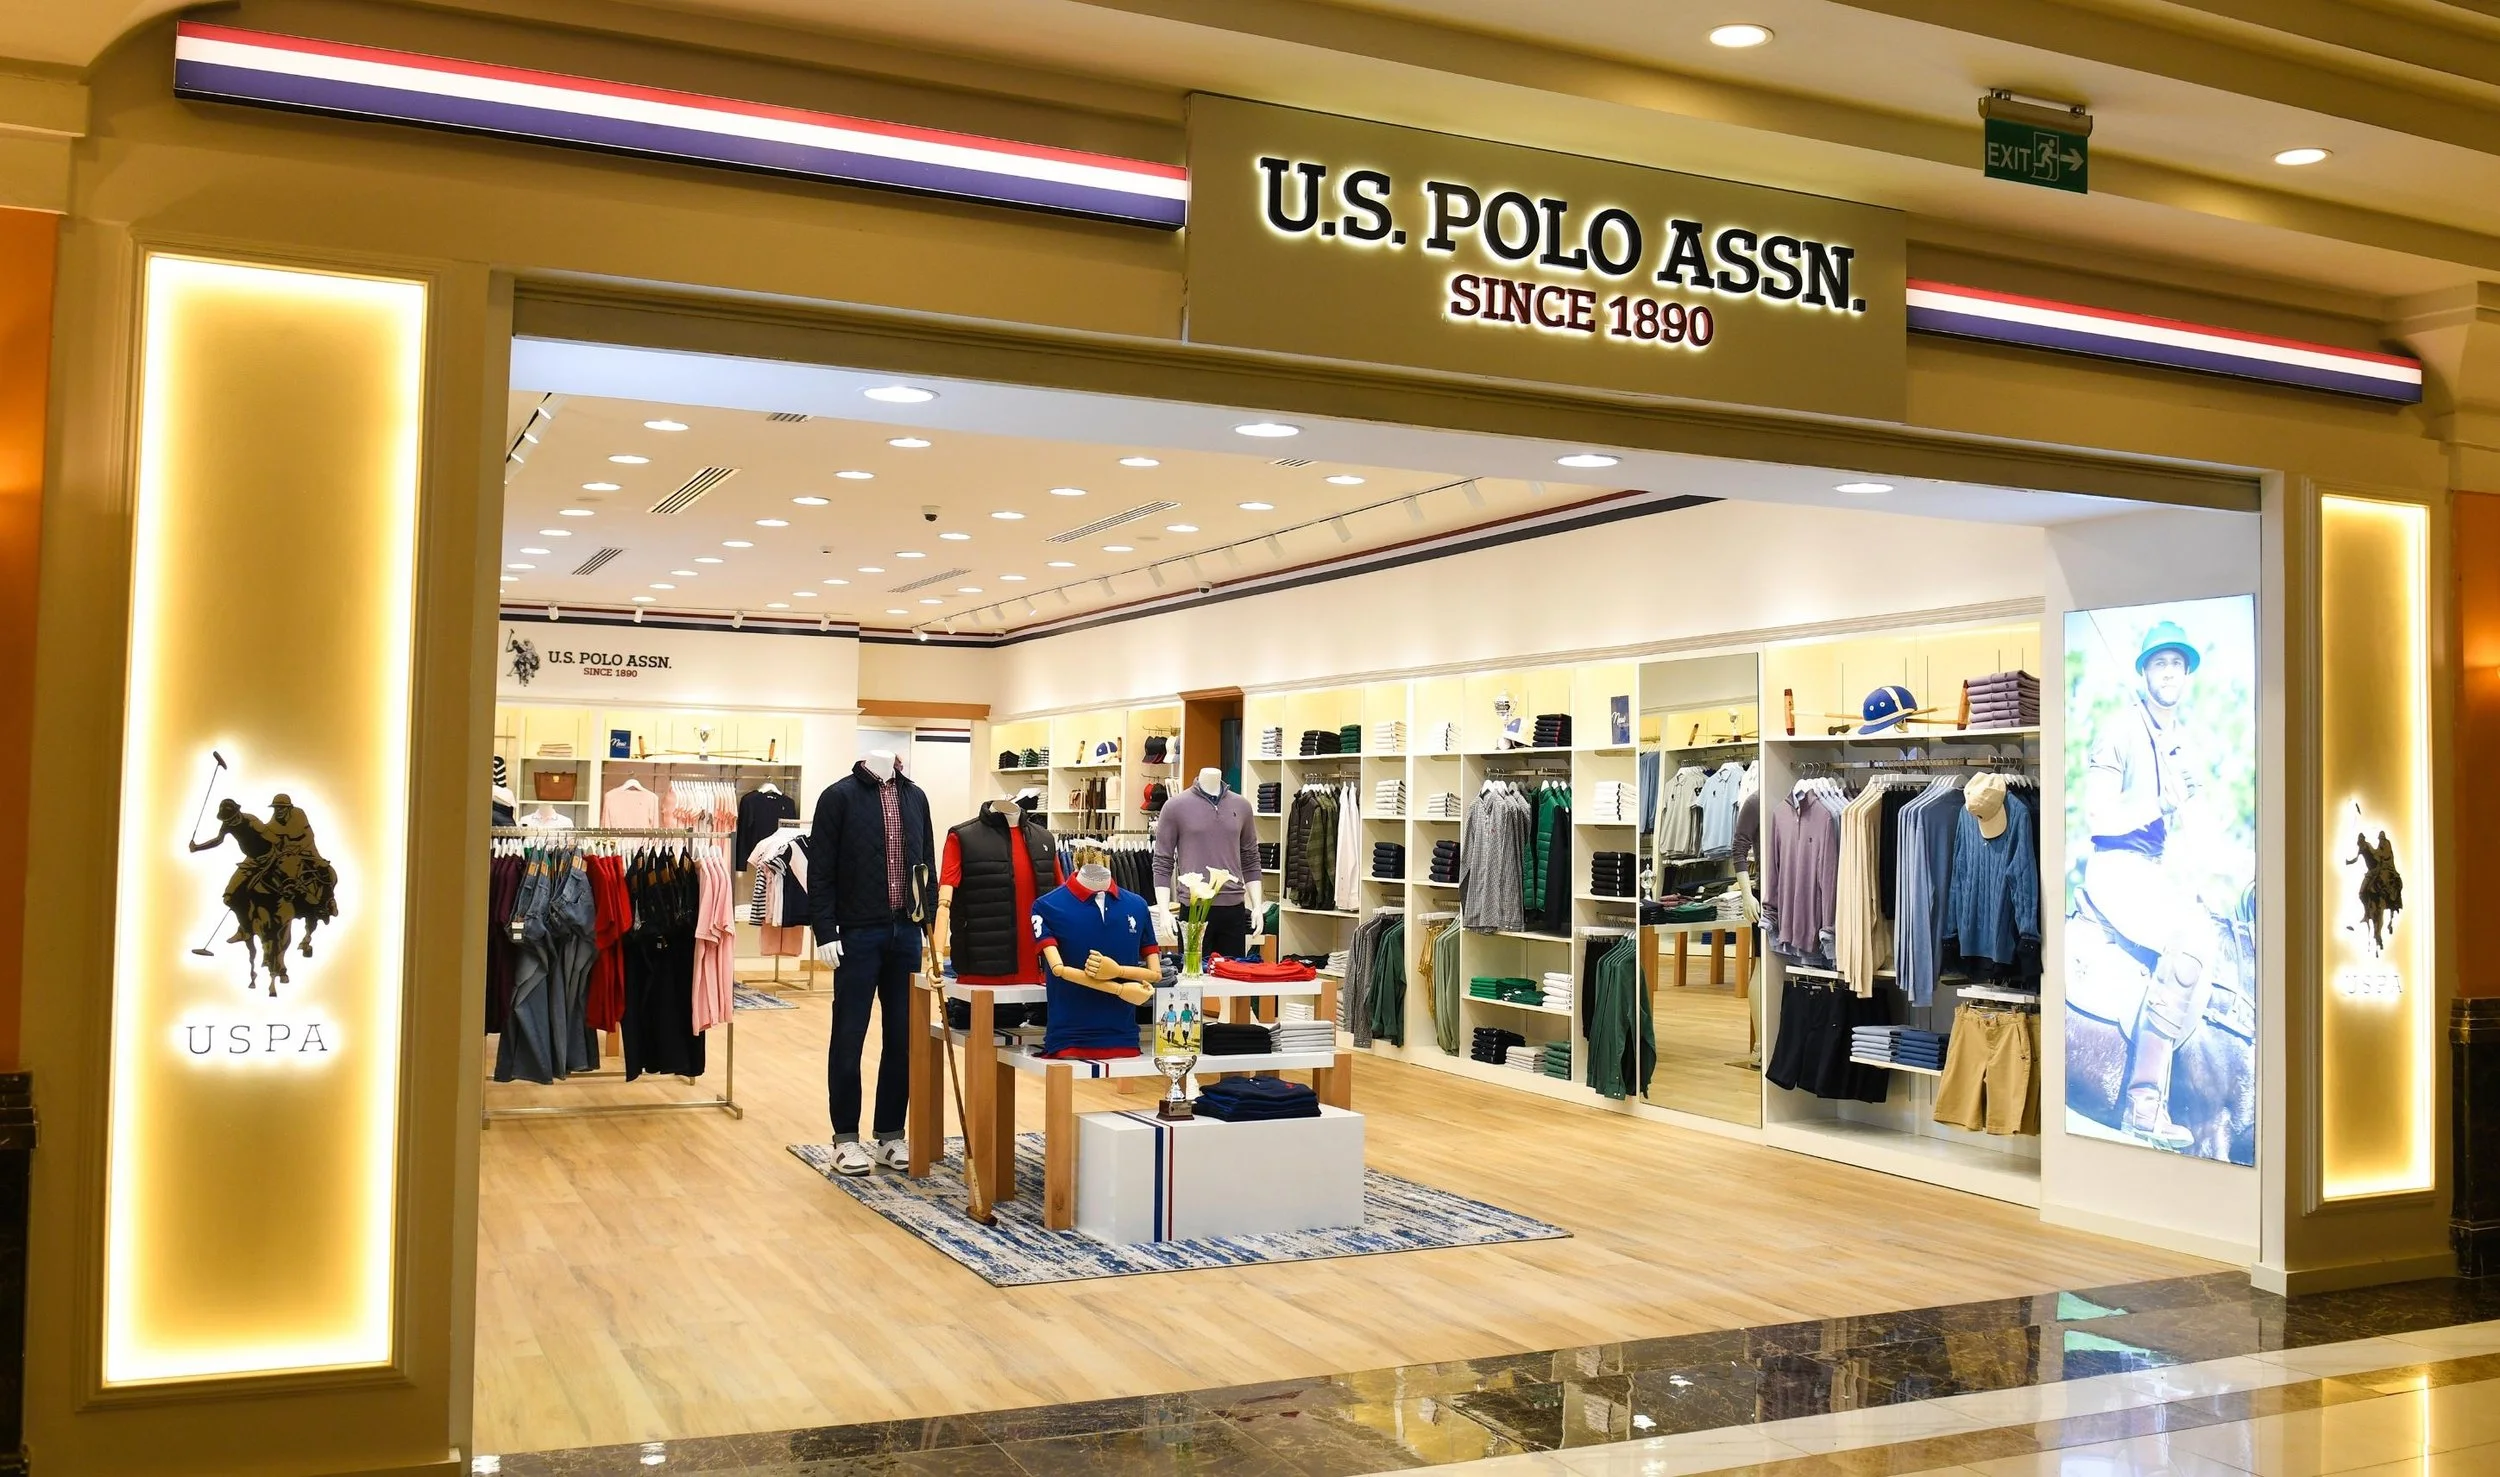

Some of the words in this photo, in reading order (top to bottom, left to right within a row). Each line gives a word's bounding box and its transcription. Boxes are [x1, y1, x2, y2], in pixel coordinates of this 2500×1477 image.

[1987, 141, 2031, 172] EXIT
[1260, 156, 1406, 245] U.S.
[1427, 180, 1642, 276] POLO
[1657, 219, 1866, 312] ASSN.
[1451, 273, 1597, 333] SINCE
[1609, 295, 1714, 347] 1890
[548, 651, 575, 664] U.S.
[579, 652, 623, 666] POLO
[626, 654, 672, 669] ASSN.
[583, 667, 613, 677] SINCE
[615, 669, 638, 678] 1890
[1031, 914, 1044, 939] 3
[186, 1023, 329, 1055] USPA
